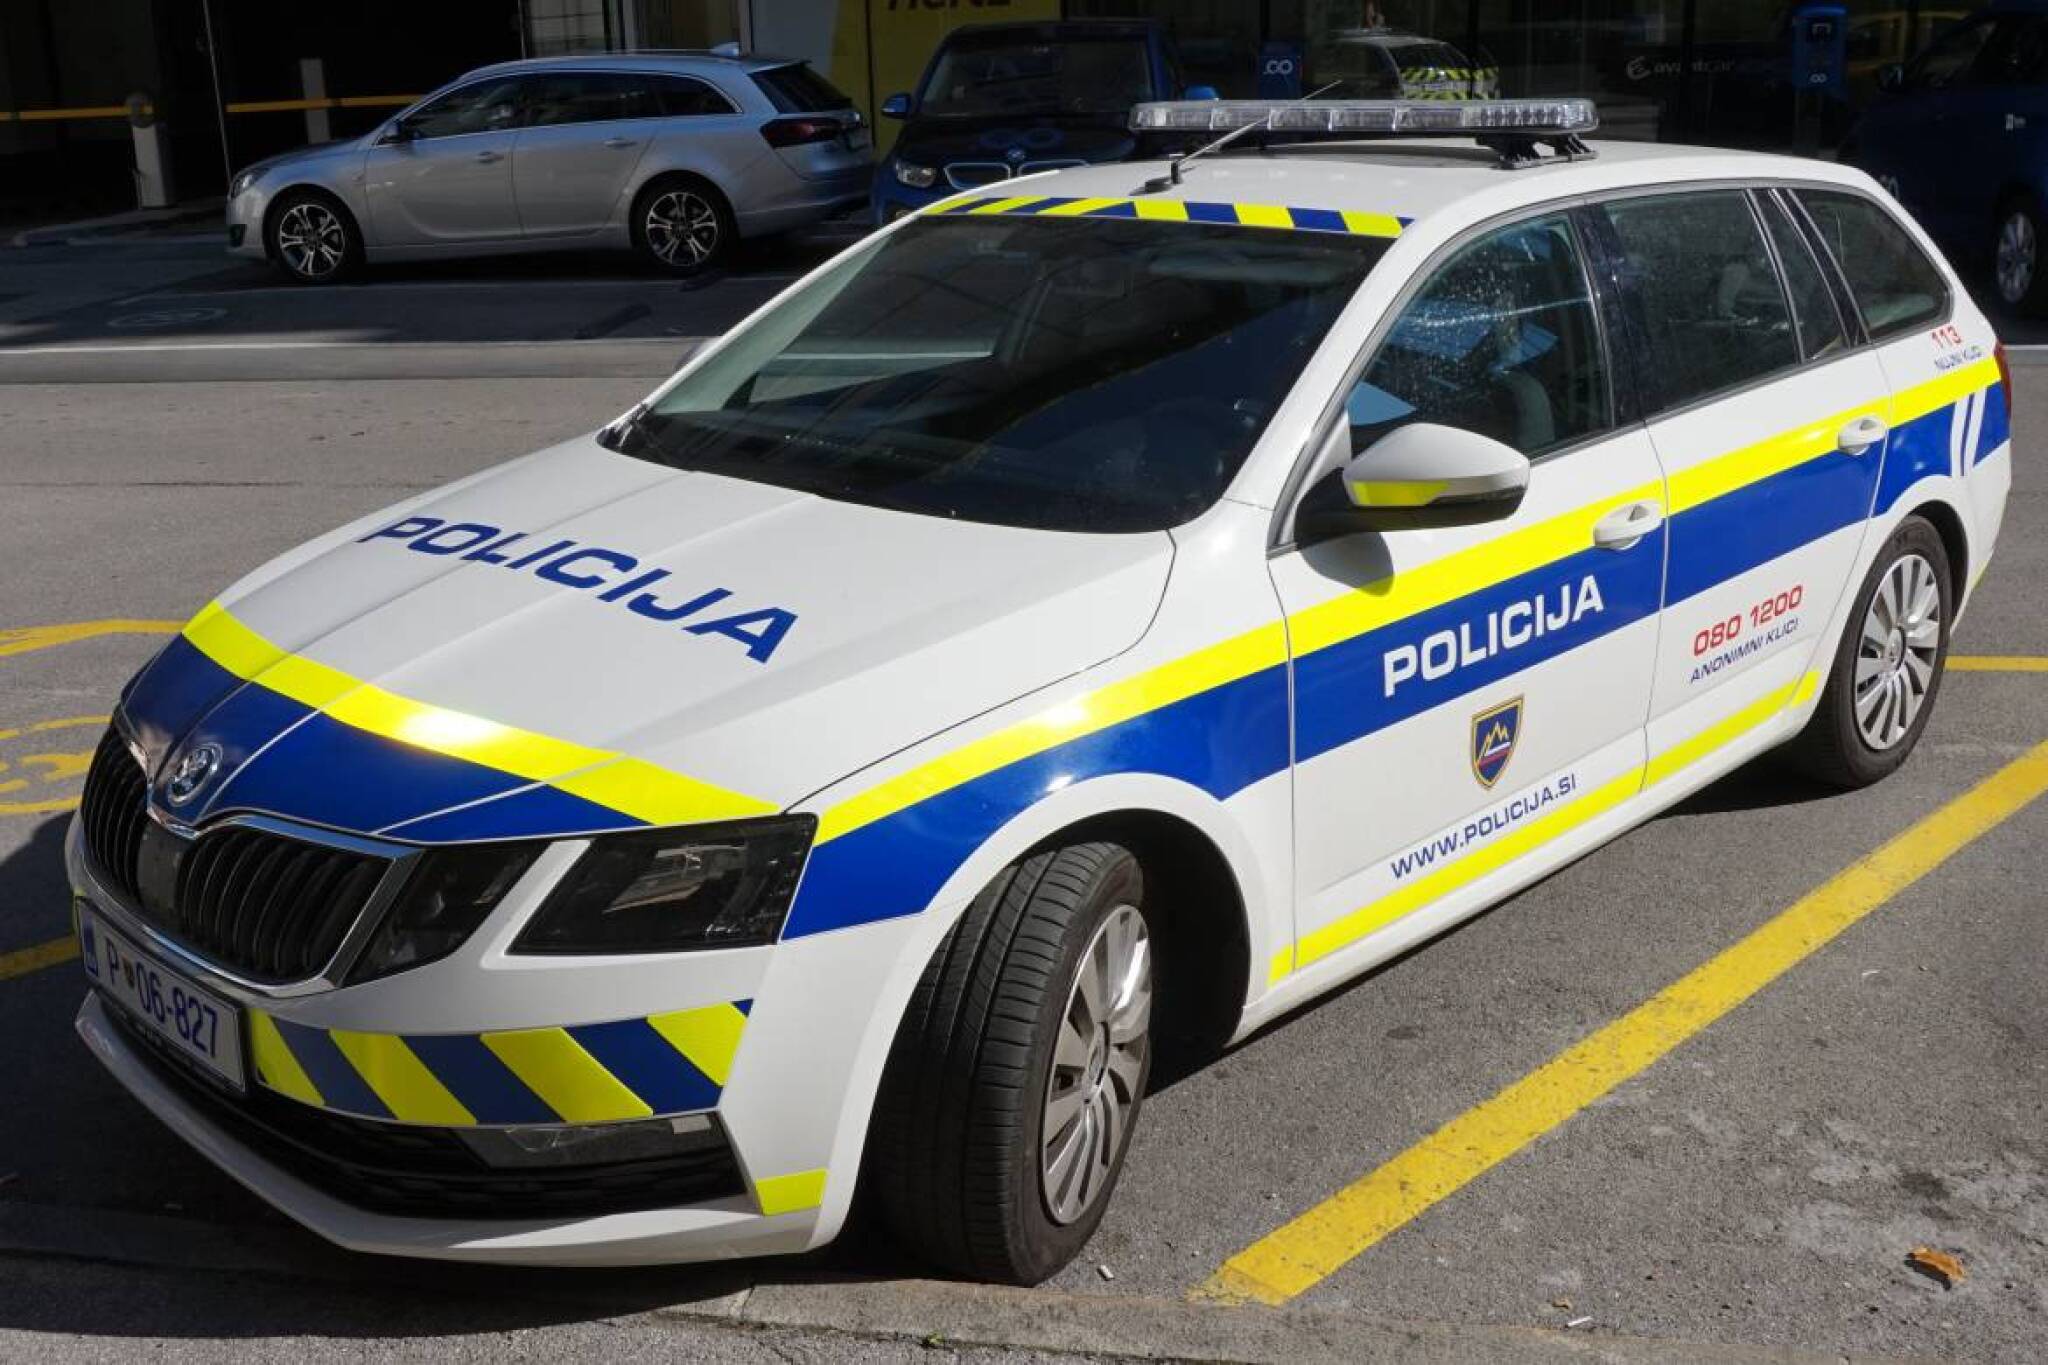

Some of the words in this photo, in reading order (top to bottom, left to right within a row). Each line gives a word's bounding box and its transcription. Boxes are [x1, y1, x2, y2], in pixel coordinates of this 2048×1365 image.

[1931, 325, 1962, 348] 113
[356, 516, 798, 664] POLICIJA
[1383, 574, 1605, 698] POLICIJA
[1694, 614, 1742, 656] 080
[1750, 585, 1803, 628] 1200
[1390, 772, 1577, 879] WWW.POLICIJA.SI
[136, 961, 217, 1058] 06-827
